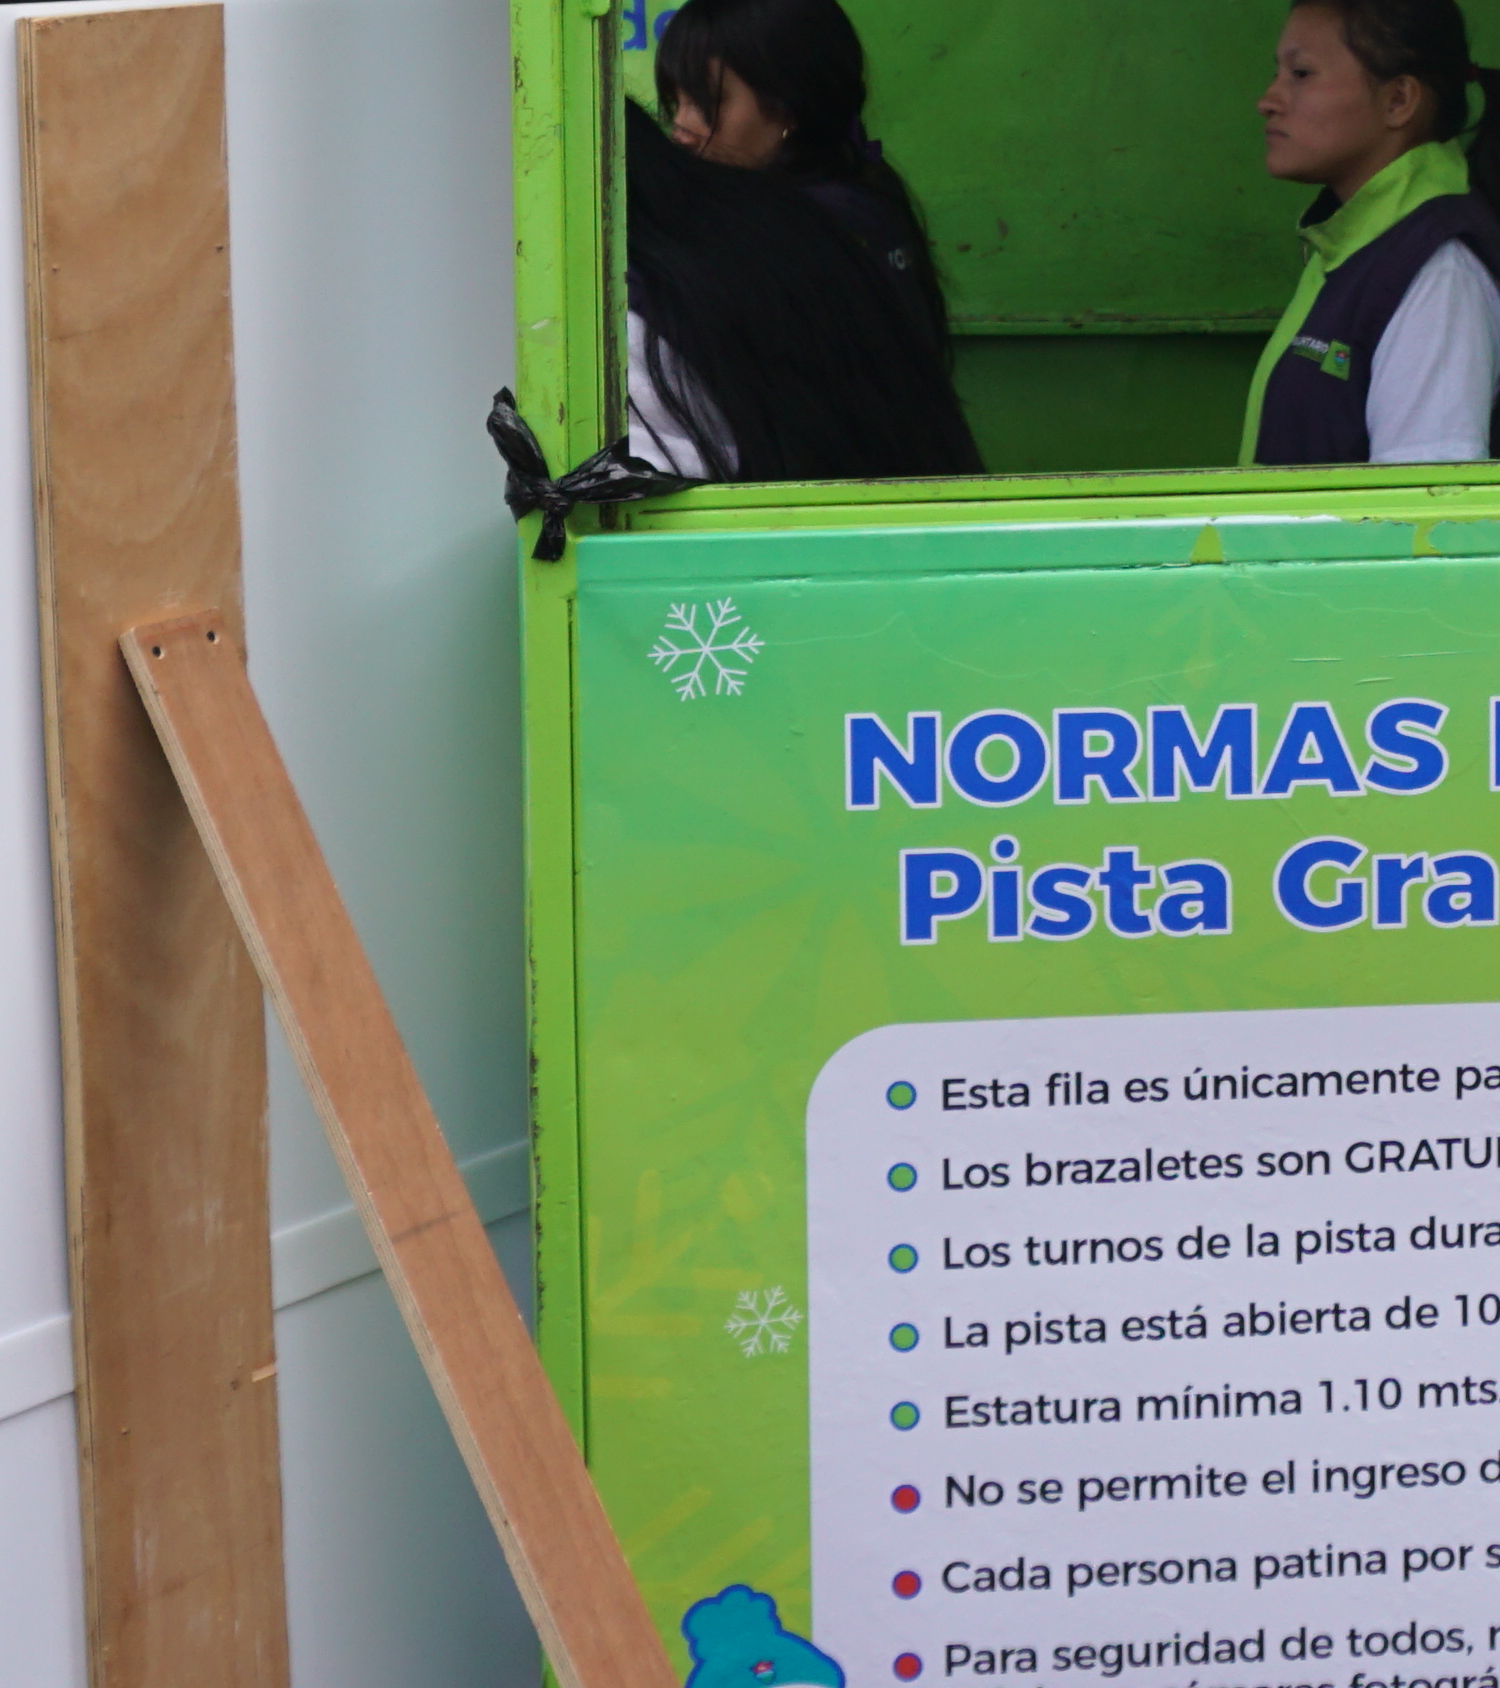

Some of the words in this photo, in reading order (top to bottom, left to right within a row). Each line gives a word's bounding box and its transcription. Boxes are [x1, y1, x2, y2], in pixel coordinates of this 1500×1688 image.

[845, 702, 1450, 812] NORMAS
[899, 833, 1234, 946] Pista
[941, 1077, 1031, 1112] Esta
[1044, 1070, 1111, 1108] fila
[1123, 1076, 1171, 1104] es
[1182, 1062, 1442, 1102] únicamente
[941, 1156, 1011, 1192] Los
[1024, 1146, 1245, 1188] brazaletes
[1255, 1149, 1332, 1178] son
[942, 1236, 1012, 1271] Los
[1023, 1235, 1165, 1267] turnos
[1176, 1224, 1232, 1261] de
[1245, 1222, 1280, 1259] la
[1295, 1219, 1396, 1266] pista
[943, 1315, 990, 1350] La
[1004, 1310, 1107, 1357] pista
[1120, 1303, 1208, 1343] está
[1222, 1300, 1372, 1339] abierta
[1384, 1294, 1440, 1331] de
[944, 1393, 1122, 1430] Estatura
[1136, 1382, 1303, 1423] mínima
[1318, 1376, 1403, 1414] 1.10
[945, 1473, 1006, 1509] No
[1016, 1477, 1065, 1506] se
[1077, 1463, 1249, 1513] permite
[1260, 1458, 1296, 1496] el
[1311, 1457, 1468, 1501] ingreso
[940, 1555, 1052, 1595] Cada
[1066, 1556, 1238, 1599] persona
[1253, 1542, 1388, 1591] patina
[1402, 1544, 1475, 1584] por
[944, 1642, 1039, 1678] Para
[1051, 1627, 1266, 1679] seguridad
[1279, 1625, 1335, 1662] de
[1345, 1619, 1474, 1659] todos,
